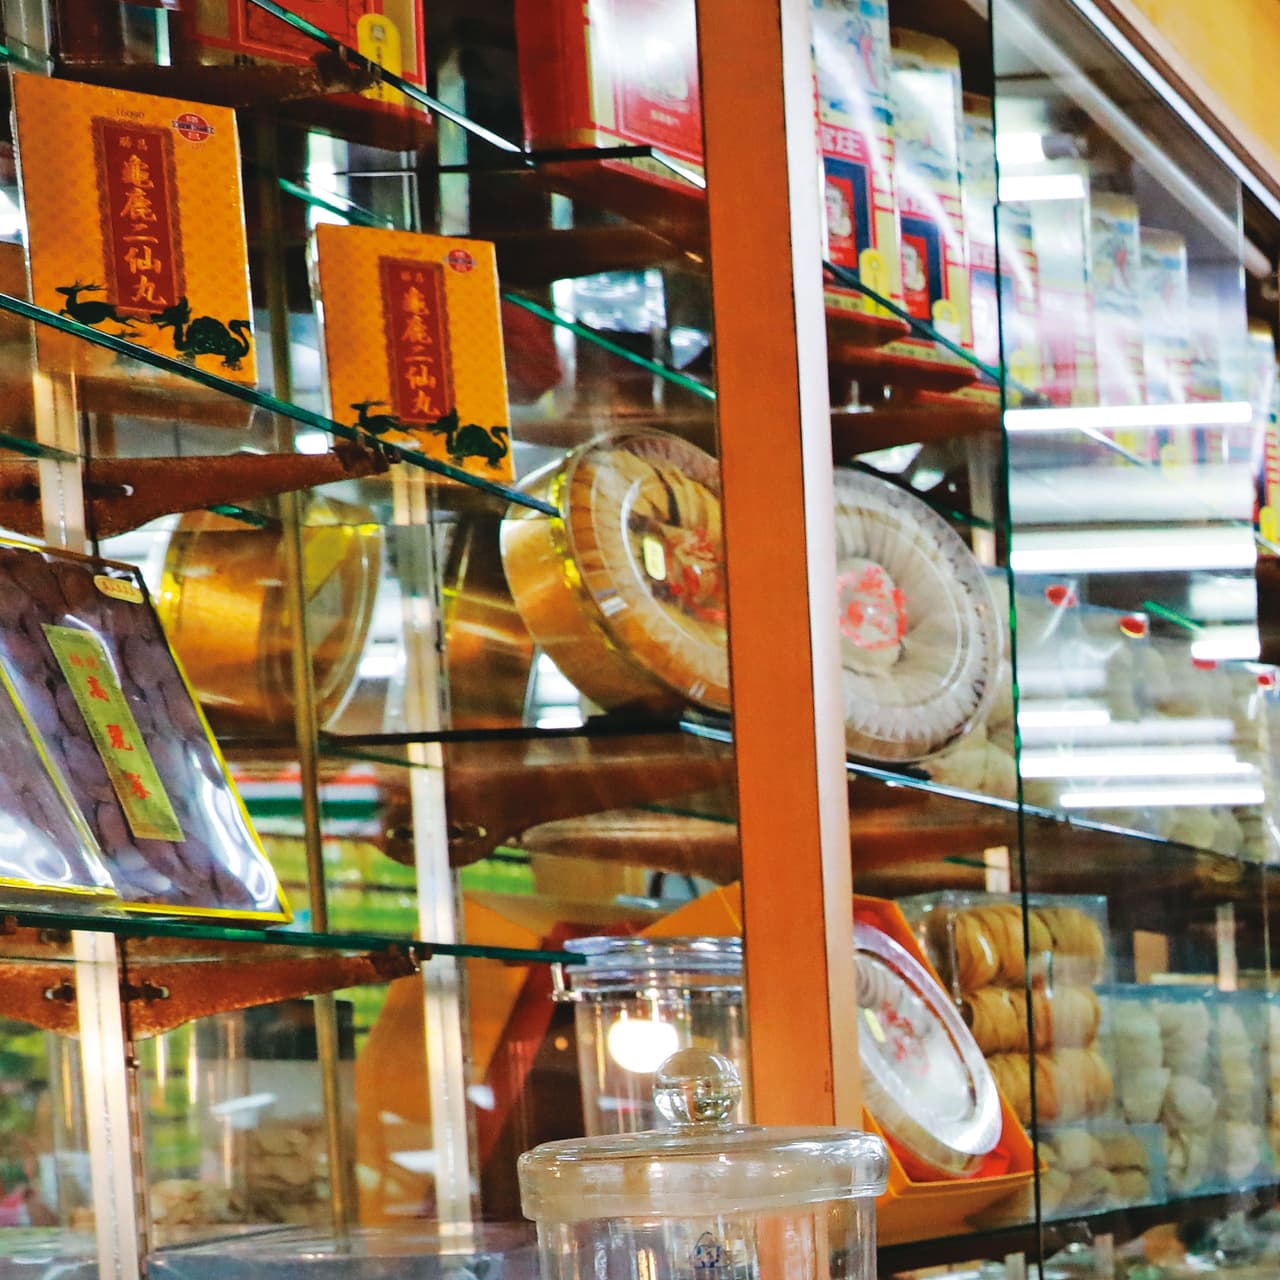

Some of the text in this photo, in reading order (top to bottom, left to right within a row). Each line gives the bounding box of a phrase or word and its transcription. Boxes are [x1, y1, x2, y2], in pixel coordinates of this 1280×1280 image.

[119, 154, 169, 306] 龜鹿二仙丸
